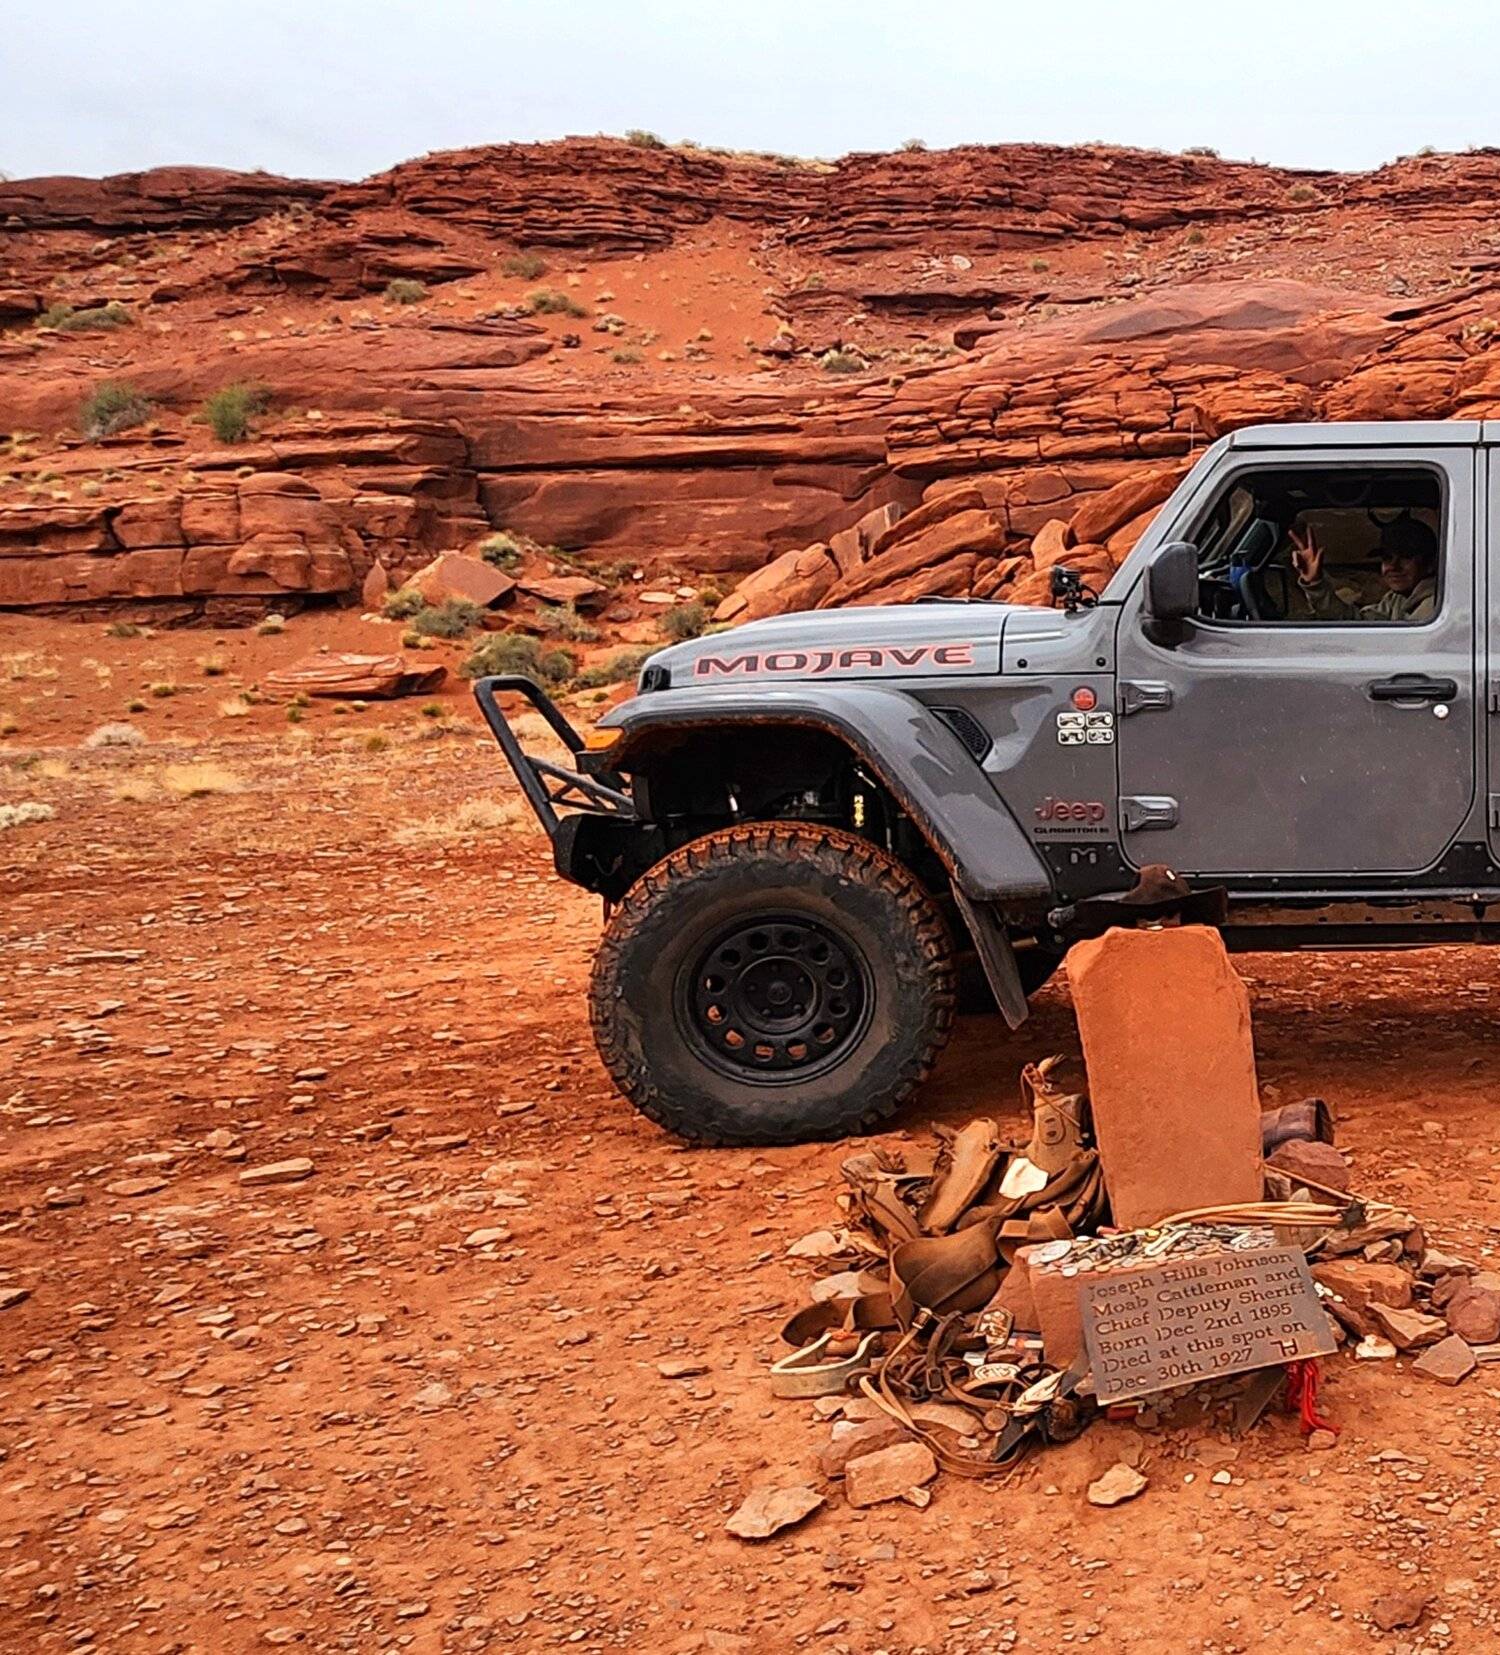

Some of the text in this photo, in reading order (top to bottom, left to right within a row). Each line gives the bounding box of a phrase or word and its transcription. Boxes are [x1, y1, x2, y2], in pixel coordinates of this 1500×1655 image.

[694, 644, 976, 677] MOJAVE
[1034, 796, 1105, 826] Jeep
[1088, 1253, 1292, 1302] Joseph Hills Johnson
[1091, 1266, 1301, 1318] Moab Cattleman and
[1095, 1281, 1306, 1335] Chief Deputy Sheriff
[1098, 1302, 1292, 1355] Born Dec 2nd 1895
[1101, 1321, 1307, 1374] Died at this spot on
[1105, 1347, 1253, 1394] Dec 30th 1927
